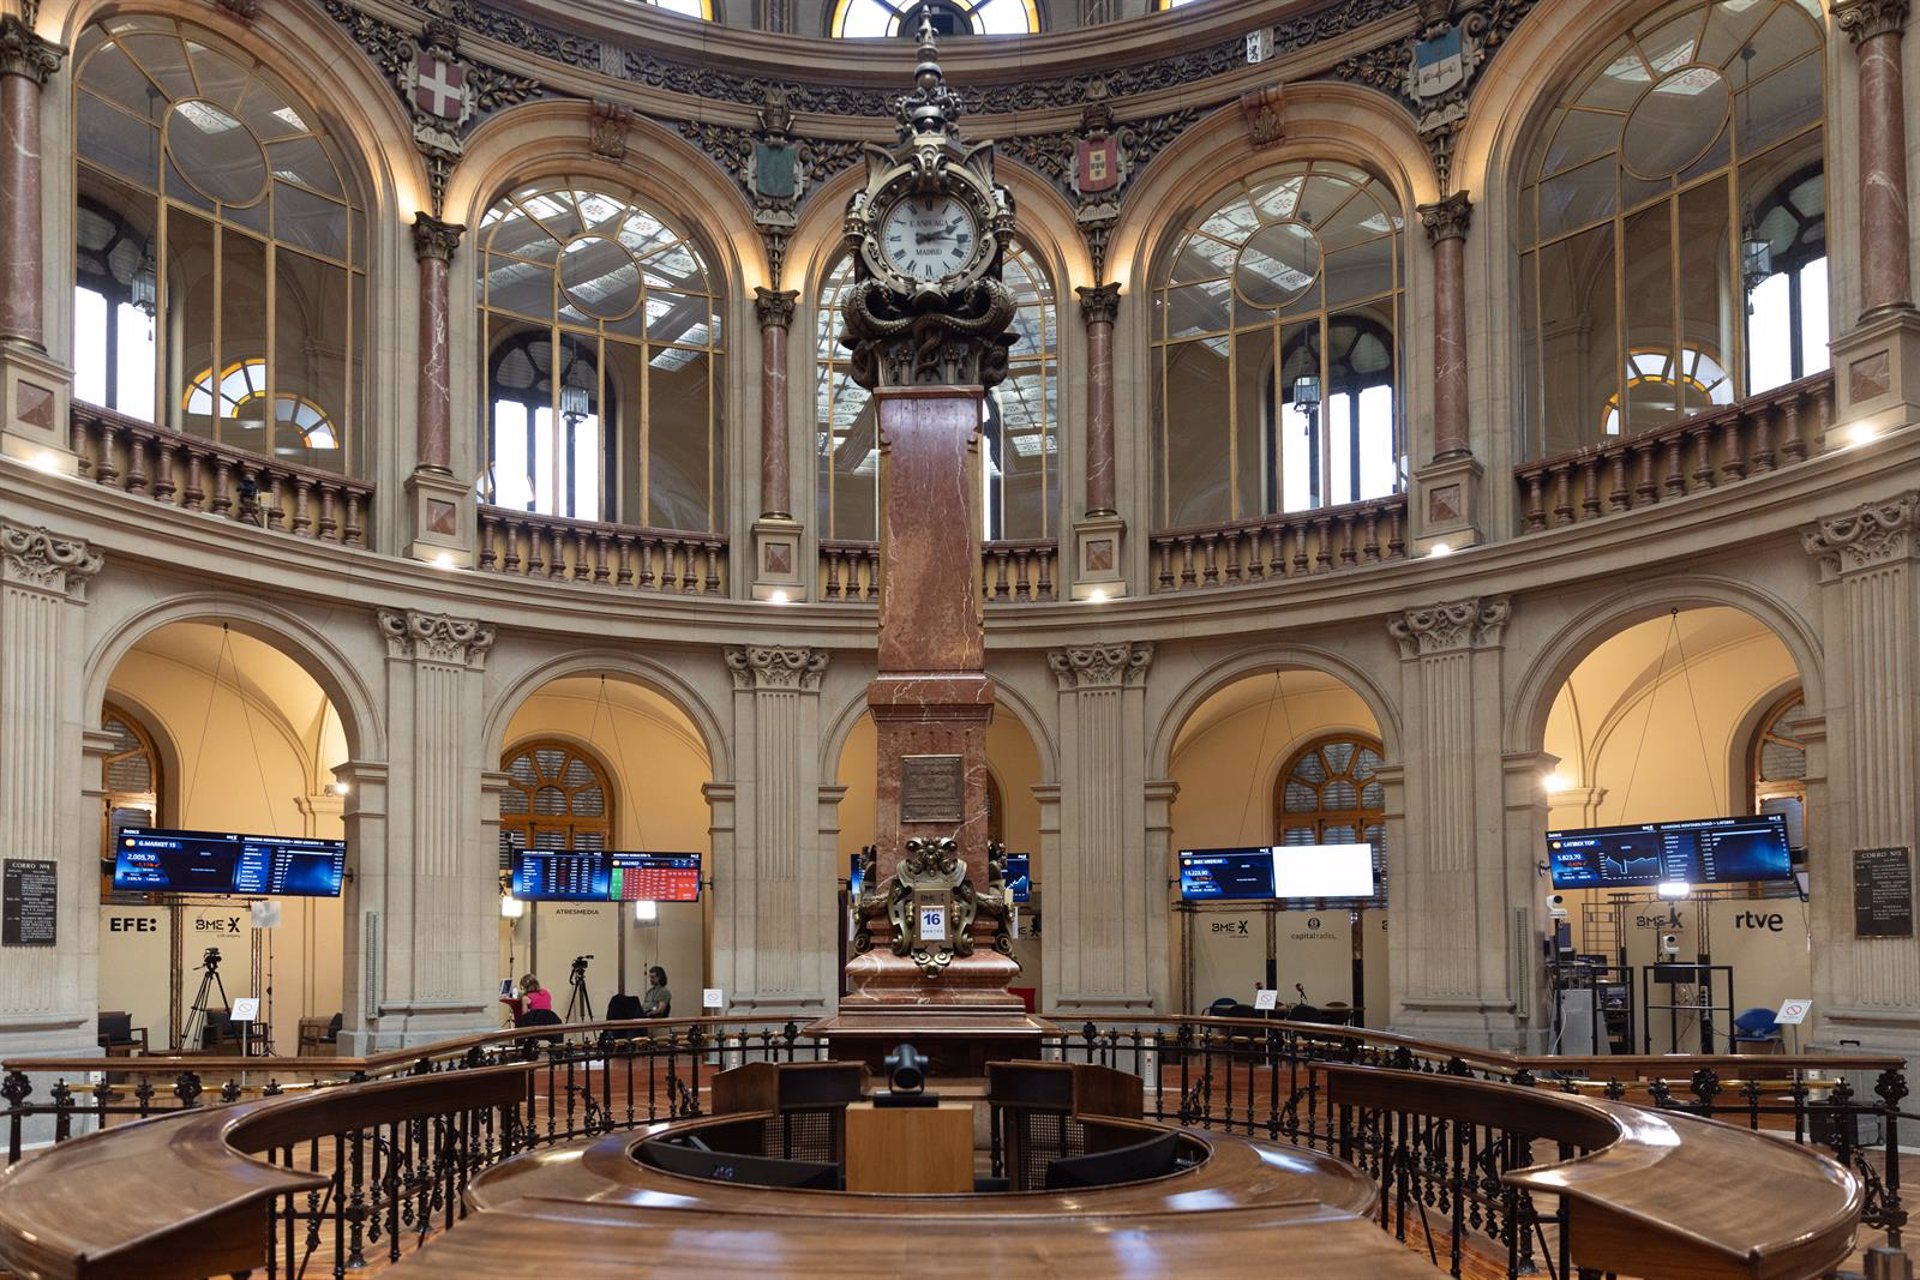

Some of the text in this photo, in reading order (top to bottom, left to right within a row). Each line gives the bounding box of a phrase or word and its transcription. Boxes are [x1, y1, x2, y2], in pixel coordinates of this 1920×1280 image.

[195, 919, 224, 930] BME
[923, 913, 941, 925] 16
[1735, 911, 1783, 931] rtve
[1211, 923, 1235, 932] BME
